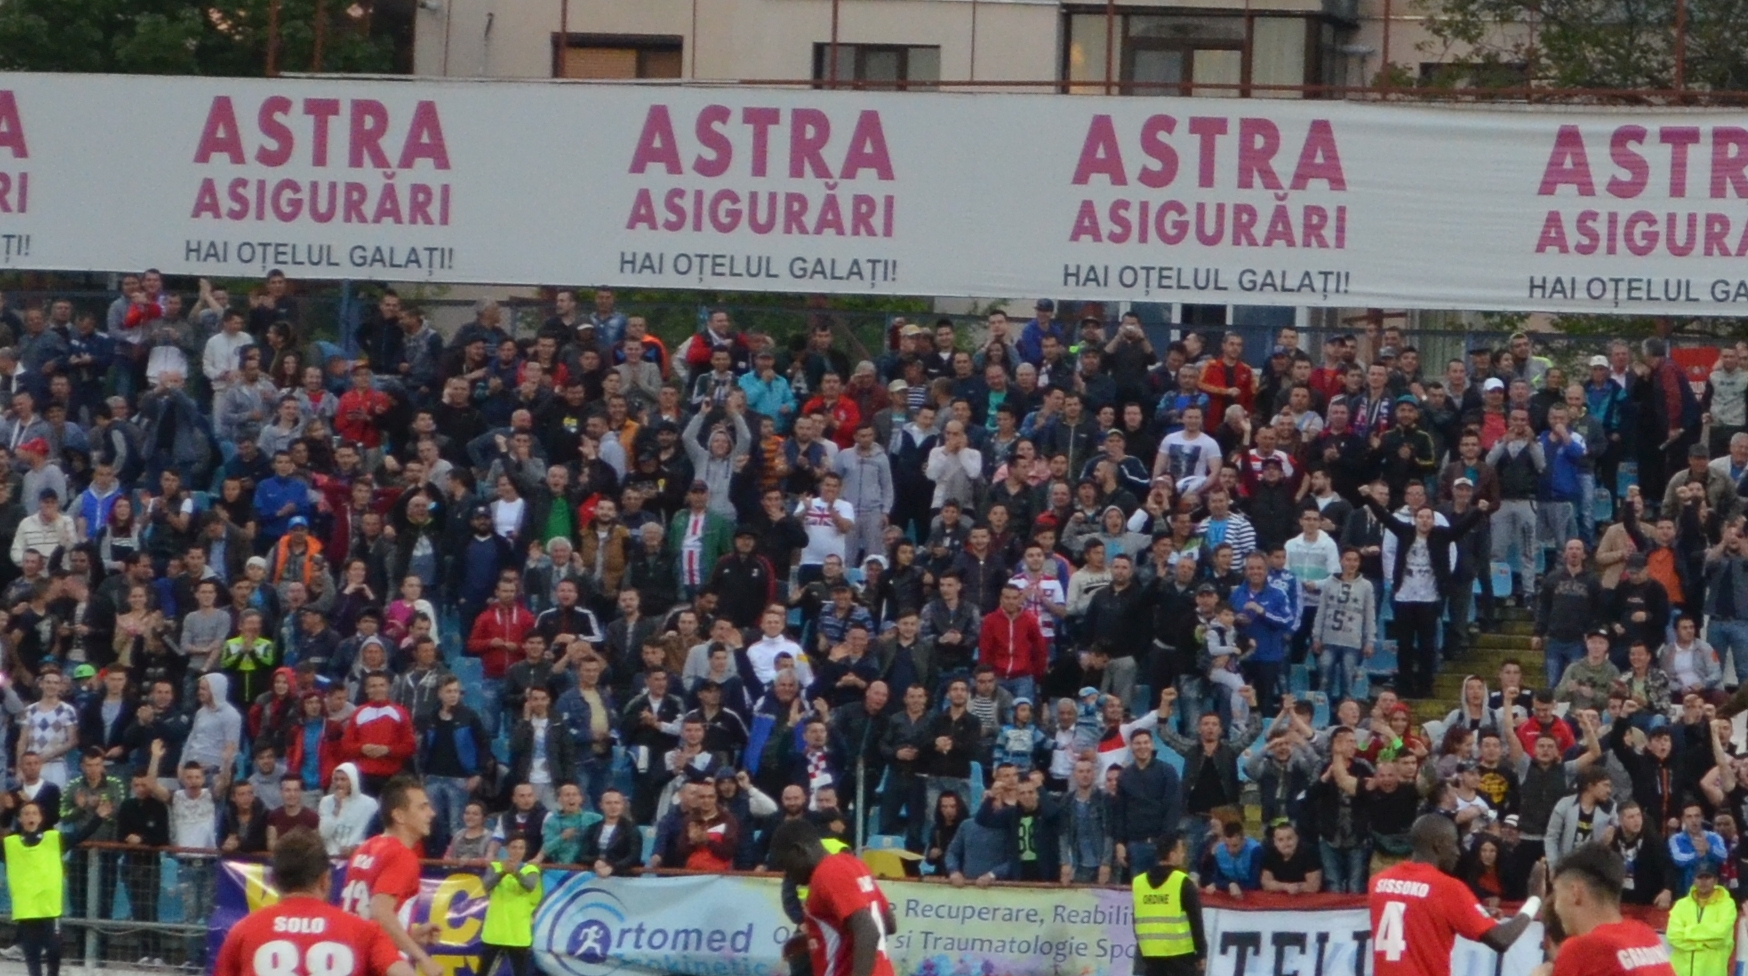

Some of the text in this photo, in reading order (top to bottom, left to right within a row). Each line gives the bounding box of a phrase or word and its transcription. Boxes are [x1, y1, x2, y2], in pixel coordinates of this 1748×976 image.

[194, 95, 451, 170] ASTRA
[629, 104, 894, 180] ASTRA
[1072, 114, 1347, 192] ASTRA
[191, 170, 450, 226] ASIGURĂRI
[626, 182, 894, 238] ASIGURĂRI
[1069, 191, 1347, 249] ASIGURĂRI
[184, 239, 453, 276] HAI OȚELUL GALAȚI!
[619, 252, 897, 289] HAI OȚELUL GALAȚI!
[1063, 264, 1350, 300] HAI OȚELUL GALAȚI!
[1529, 276, 1576, 300] HAI
[1586, 278, 1700, 308] OȚELUL
[1375, 878, 1430, 898] SISSOKO
[273, 917, 325, 934] SOLO
[905, 898, 1045, 926] Recuperare,
[1053, 904, 1136, 926] Reabili
[895, 929, 913, 950] si
[920, 931, 1088, 962] Traumatologie
[1374, 900, 1407, 962] 4
